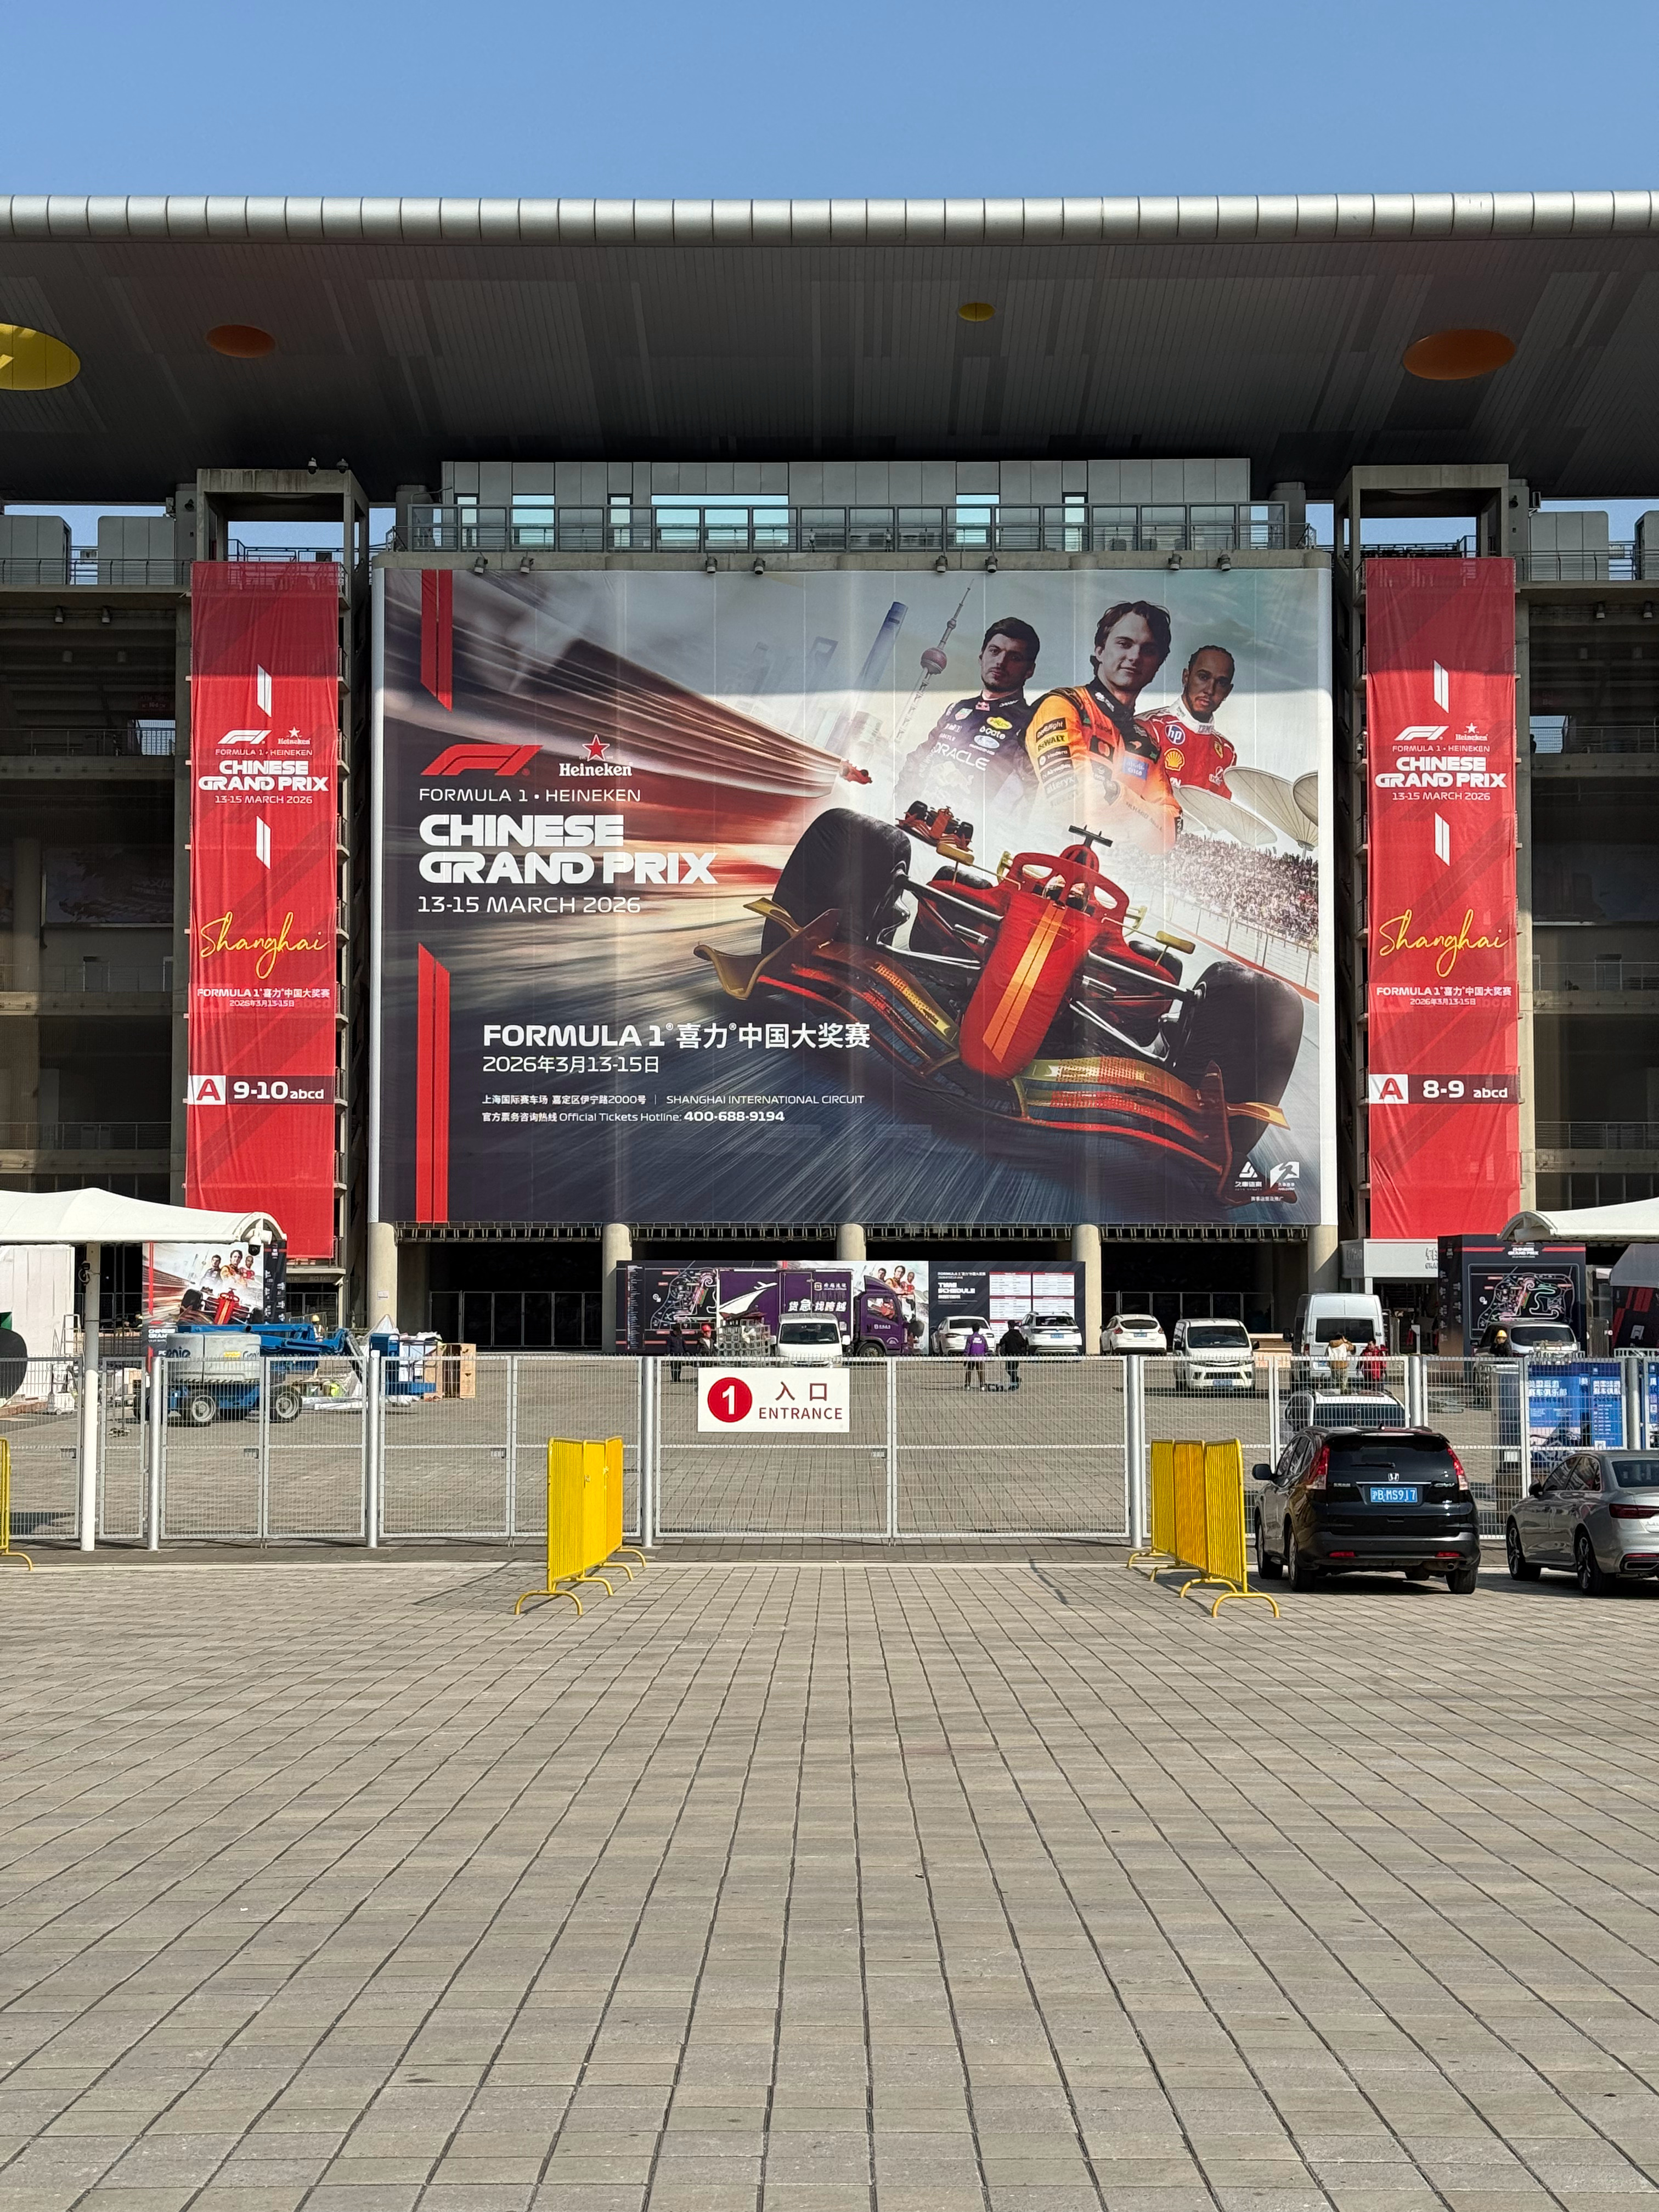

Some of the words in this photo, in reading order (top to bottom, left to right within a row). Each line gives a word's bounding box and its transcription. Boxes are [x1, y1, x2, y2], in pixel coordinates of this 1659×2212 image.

[1167, 725, 1183, 744] hp
[934, 742, 990, 771] ORACLE
[1396, 757, 1486, 771] CHINESE
[219, 760, 308, 775] CHINESE
[558, 763, 632, 777] Heineken
[198, 776, 275, 791] GRAND
[278, 776, 329, 791] PRIX
[1375, 772, 1453, 787] GRAND
[1456, 773, 1507, 788] PRIX
[215, 795, 242, 804] 13-15
[244, 795, 284, 804] MARCH
[286, 795, 313, 804] 2026
[419, 788, 511, 802] FORMULA
[519, 789, 528, 802] 1
[545, 789, 641, 802] HEINEKEN
[1392, 792, 1420, 800] 13-15
[1423, 792, 1463, 800] MARCH
[1465, 792, 1491, 800] 2026
[419, 814, 624, 847] CHINESE
[419, 851, 595, 884] GRAND
[602, 852, 718, 884] PRIX
[417, 896, 479, 913] 13-15
[487, 896, 576, 913] MARCH
[583, 896, 641, 913] 2026
[200, 911, 330, 979] Shanghai
[1379, 909, 1509, 978] Shanghai
[198, 989, 252, 997] FORMULA
[1376, 988, 1432, 996] FORMULA
[483, 1024, 642, 1047] FORMULA
[482, 1056, 659, 1074] 2026年3月13-15日
[196, 1079, 221, 1101] A
[1379, 1077, 1403, 1099] A
[1423, 1080, 1464, 1098] 8-9
[1473, 1087, 1508, 1098] abcd
[482, 1095, 548, 1104] 上海国际赛车场
[551, 1095, 647, 1105] 嘉定区伊宁路2000号
[666, 1095, 725, 1104] SHANGHAI
[729, 1095, 820, 1104] INTERNATIONAL
[821, 1095, 865, 1104] CIRCUIT
[482, 1113, 557, 1122] 官方票务咨询热线
[559, 1113, 597, 1122] Official
[599, 1113, 639, 1122] Tickets
[640, 1113, 682, 1122] Hotline:
[684, 1111, 785, 1122] 400-688-9194
[722, 1385, 735, 1415] 1
[775, 1381, 827, 1401] 入口
[759, 1407, 842, 1420] ENTRANCE
